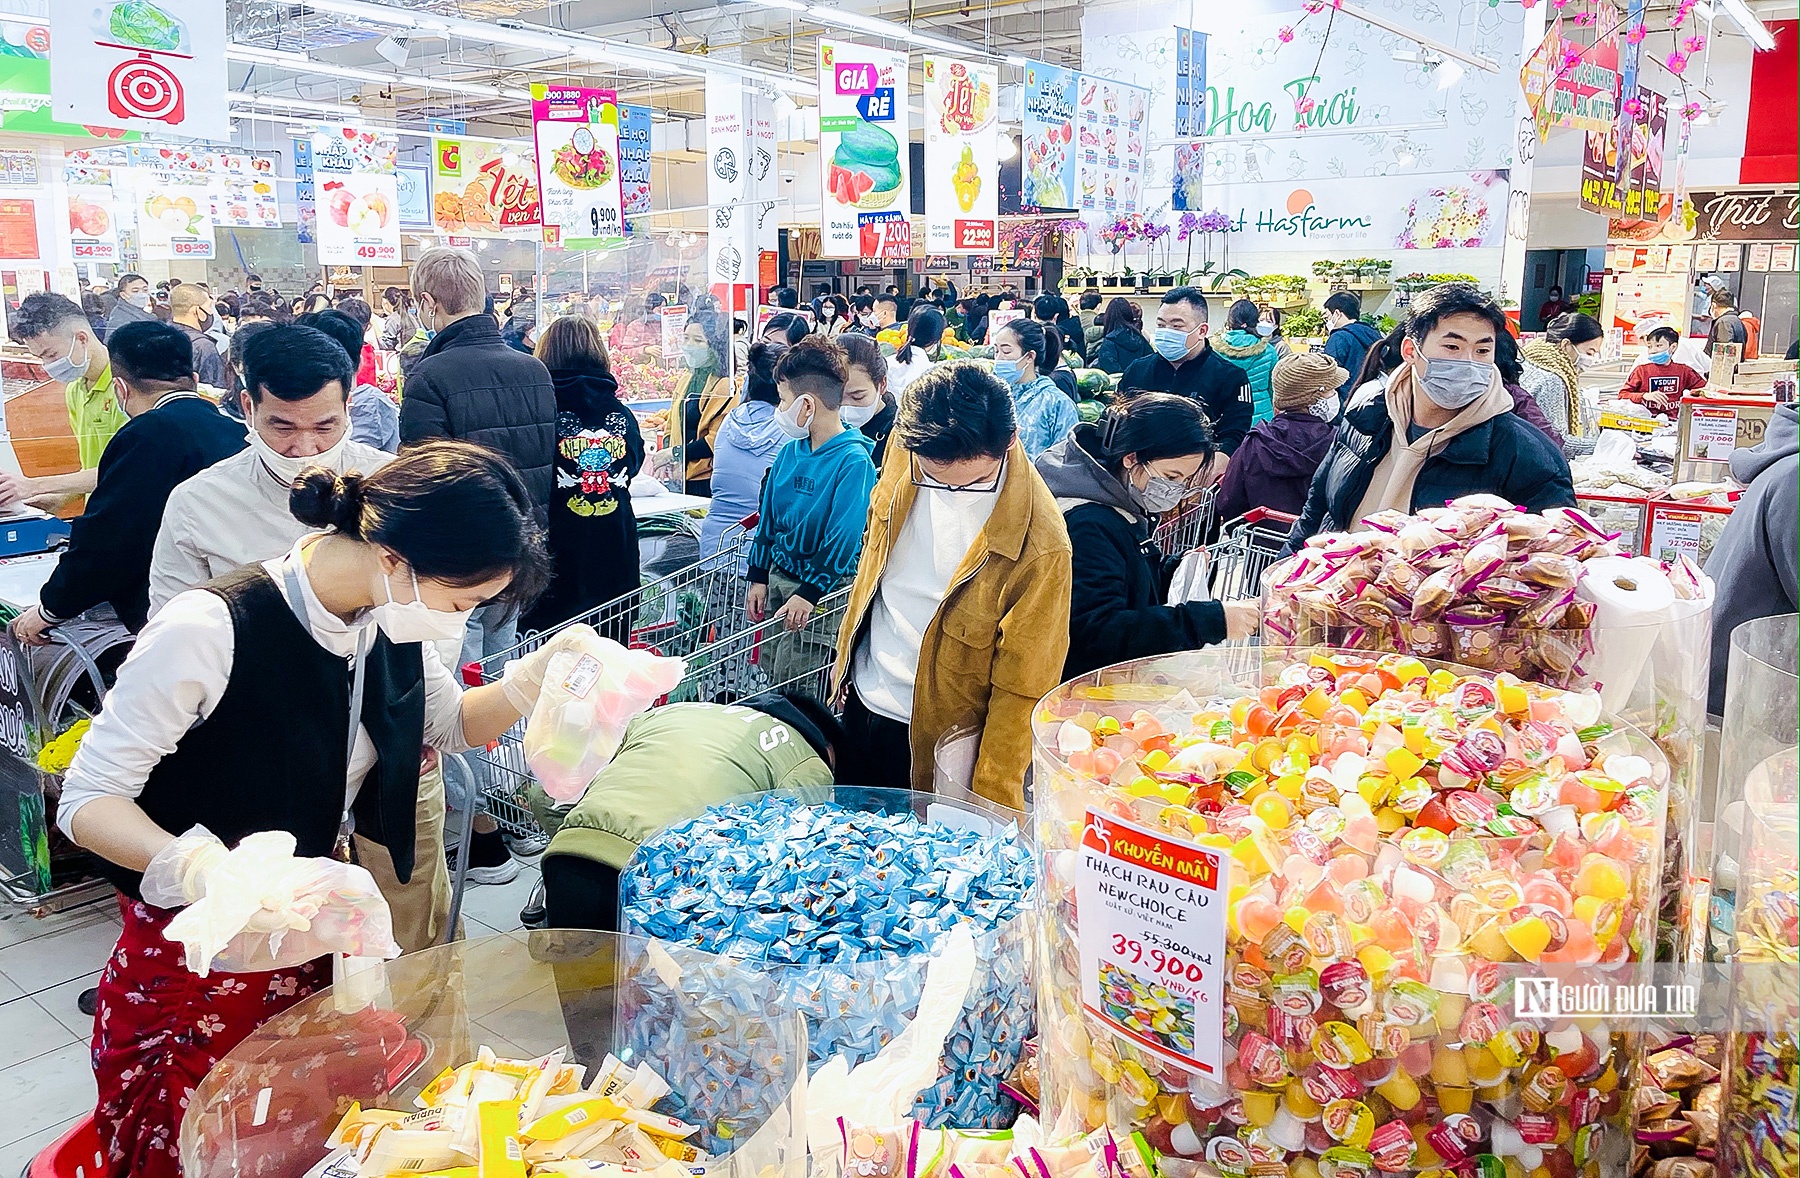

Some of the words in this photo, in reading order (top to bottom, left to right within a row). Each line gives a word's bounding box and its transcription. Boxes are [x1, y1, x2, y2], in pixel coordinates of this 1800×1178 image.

[839, 64, 869, 91] GIÁ
[867, 89, 891, 117] RẺ
[1027, 96, 1051, 117] NHẬP
[1206, 86, 1277, 137] Hoa
[1283, 75, 1361, 129] Tươi
[619, 148, 650, 164] NHẬP
[480, 157, 533, 207] Tết
[1255, 205, 1371, 238] Hasfarm
[1703, 194, 1771, 230] Thịt
[175, 243, 209, 253] 89.900
[962, 228, 992, 246] 22.900
[1336, 234, 1352, 242] your
[1354, 232, 1368, 240] life
[75, 246, 113, 256] 54.900
[357, 246, 395, 258] 49.900
[1698, 434, 1734, 443] 389.000
[1667, 539, 1699, 548] 92.900
[1113, 838, 1174, 871] KHUYẾN
[1176, 858, 1210, 882] MÃI
[1085, 855, 1133, 883] THẠCH
[1136, 874, 1170, 895] RAU
[1098, 880, 1189, 923] NEWCHOICE
[1111, 933, 1204, 983] 39.900
[1160, 975, 1209, 1003] VNĐ/KG
[495, 1062, 529, 1076] ORANG
